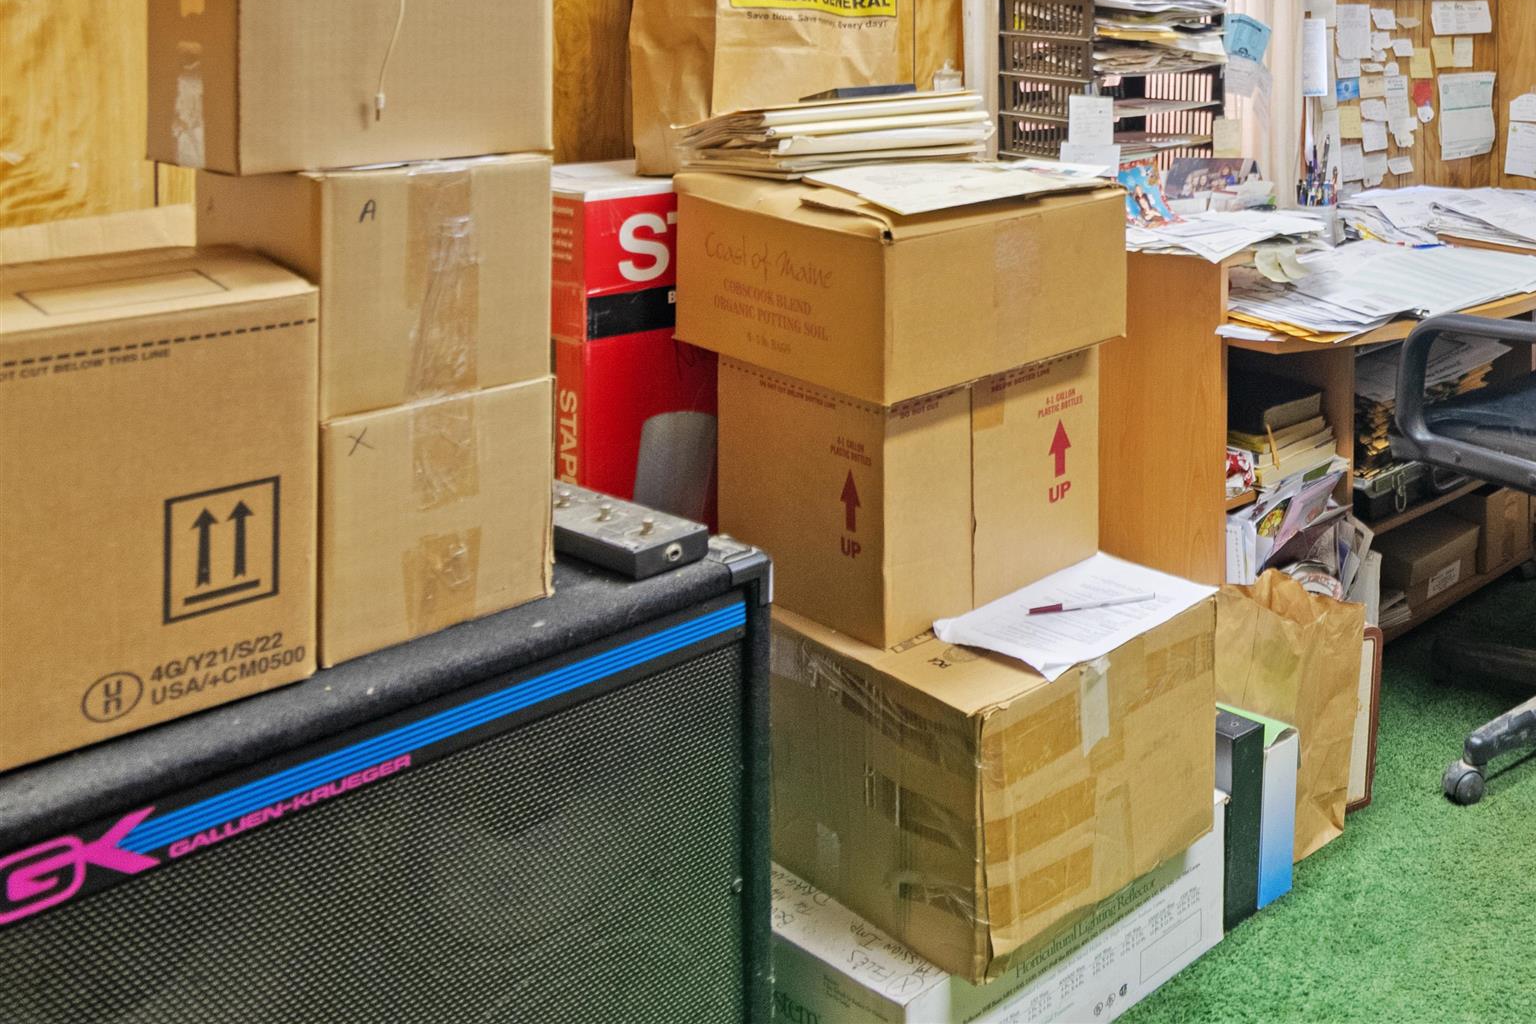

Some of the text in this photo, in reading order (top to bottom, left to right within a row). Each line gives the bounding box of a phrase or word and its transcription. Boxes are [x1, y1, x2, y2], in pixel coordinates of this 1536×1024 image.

[359, 199, 377, 224] A
[705, 231, 834, 289] Coast of Maine
[713, 295, 755, 318] ORGANIC
[757, 307, 802, 334] POTTING
[776, 294, 812, 316] BLEND
[53, 359, 105, 374] BELOW
[109, 353, 139, 366] THIS
[141, 348, 171, 362] LINE
[1038, 395, 1084, 419] PLASTIC BOTTLES
[1054, 387, 1077, 404] GALLON
[1048, 480, 1072, 504] UP
[840, 535, 863, 559] UP
[149, 632, 284, 682] 4G/Y21/S/22
[150, 645, 306, 706] USA/+CM0500
[168, 754, 412, 859] GALLIEN-KRUEGER
[0, 805, 162, 926] GK
[1014, 877, 1157, 978] Horticultural Lighting Reflector
